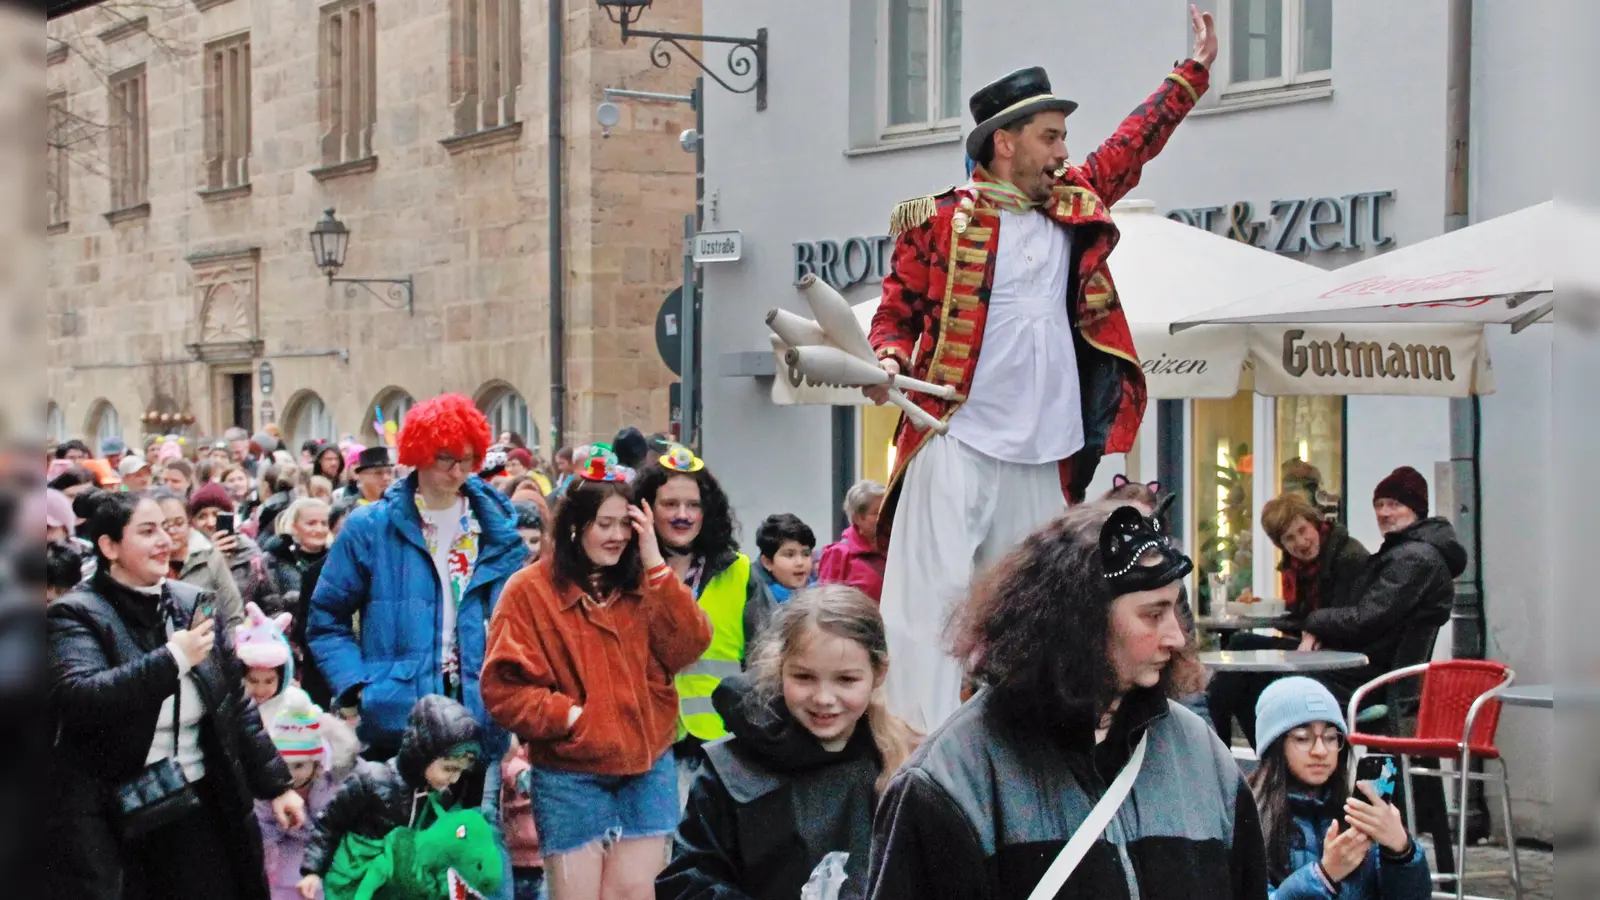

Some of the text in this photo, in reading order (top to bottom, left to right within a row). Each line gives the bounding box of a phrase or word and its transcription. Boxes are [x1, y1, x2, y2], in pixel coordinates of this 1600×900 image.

[700, 238, 735, 255] Uzstraße
[1141, 353, 1208, 375] eizen
[1282, 328, 1456, 381] Gutmann
